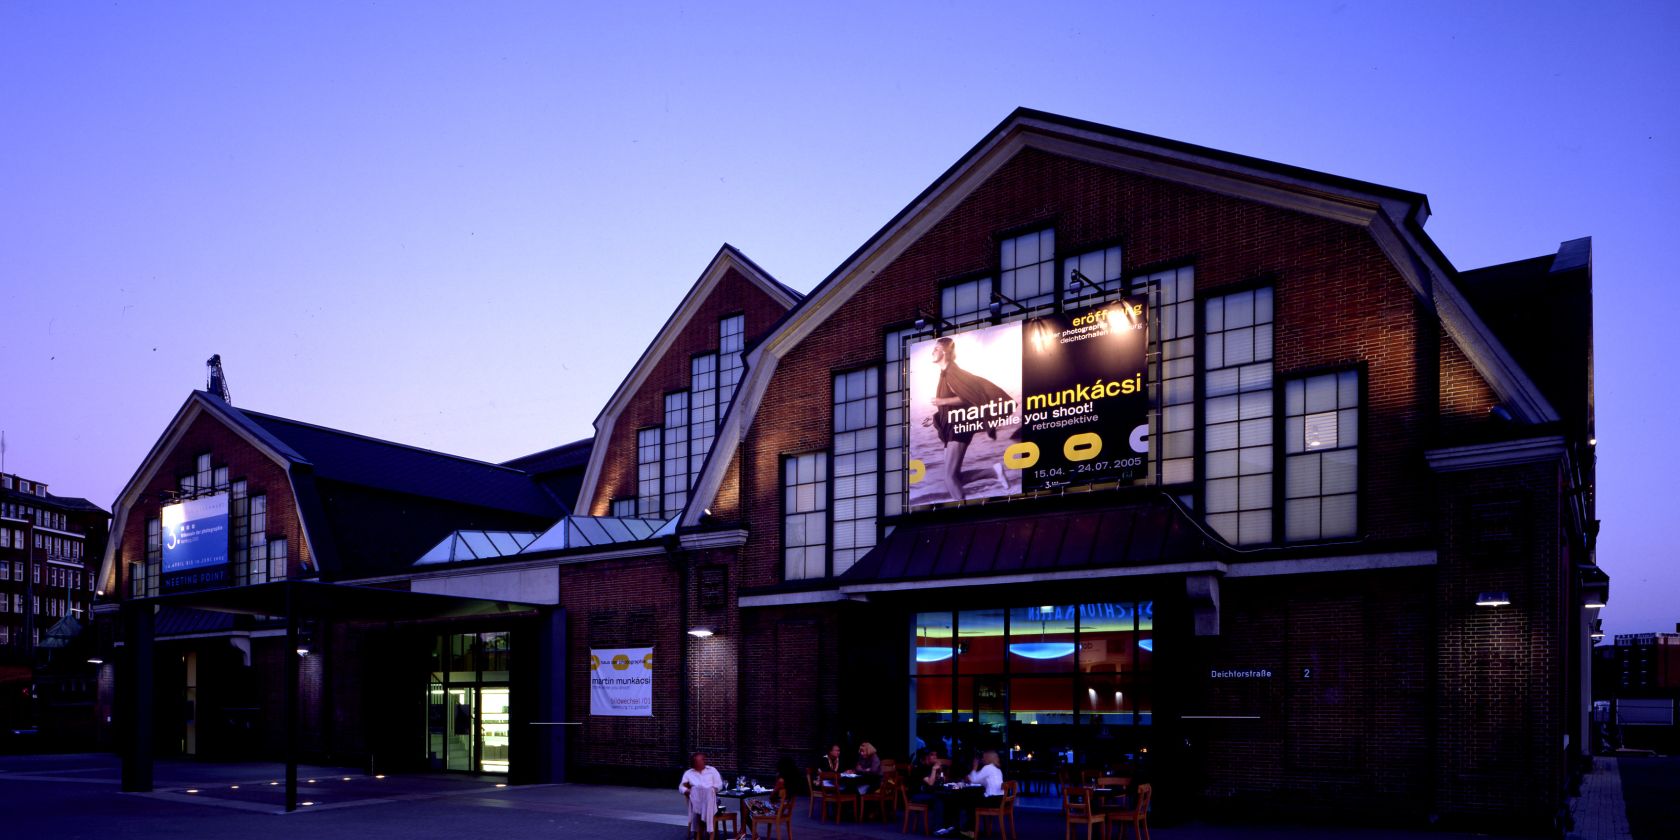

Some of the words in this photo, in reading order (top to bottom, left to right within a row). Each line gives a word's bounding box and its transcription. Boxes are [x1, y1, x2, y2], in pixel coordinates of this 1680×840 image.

[947, 397, 1017, 424] martin
[1026, 373, 1141, 410] munkácsi
[953, 419, 984, 434] think
[988, 414, 1020, 429] while
[1024, 410, 1048, 425] you
[1052, 402, 1094, 419] shoot!
[1032, 414, 1099, 431] retrospektive
[1034, 467, 1066, 479] 15.04.
[1078, 457, 1142, 474] 24.07.2005
[165, 574, 198, 587] MEETING
[200, 570, 224, 583] POINT
[591, 676, 615, 685] martin
[616, 675, 651, 685] munkácsi
[1211, 669, 1272, 678] Deichtorstraße
[1303, 668, 1310, 678] 2
